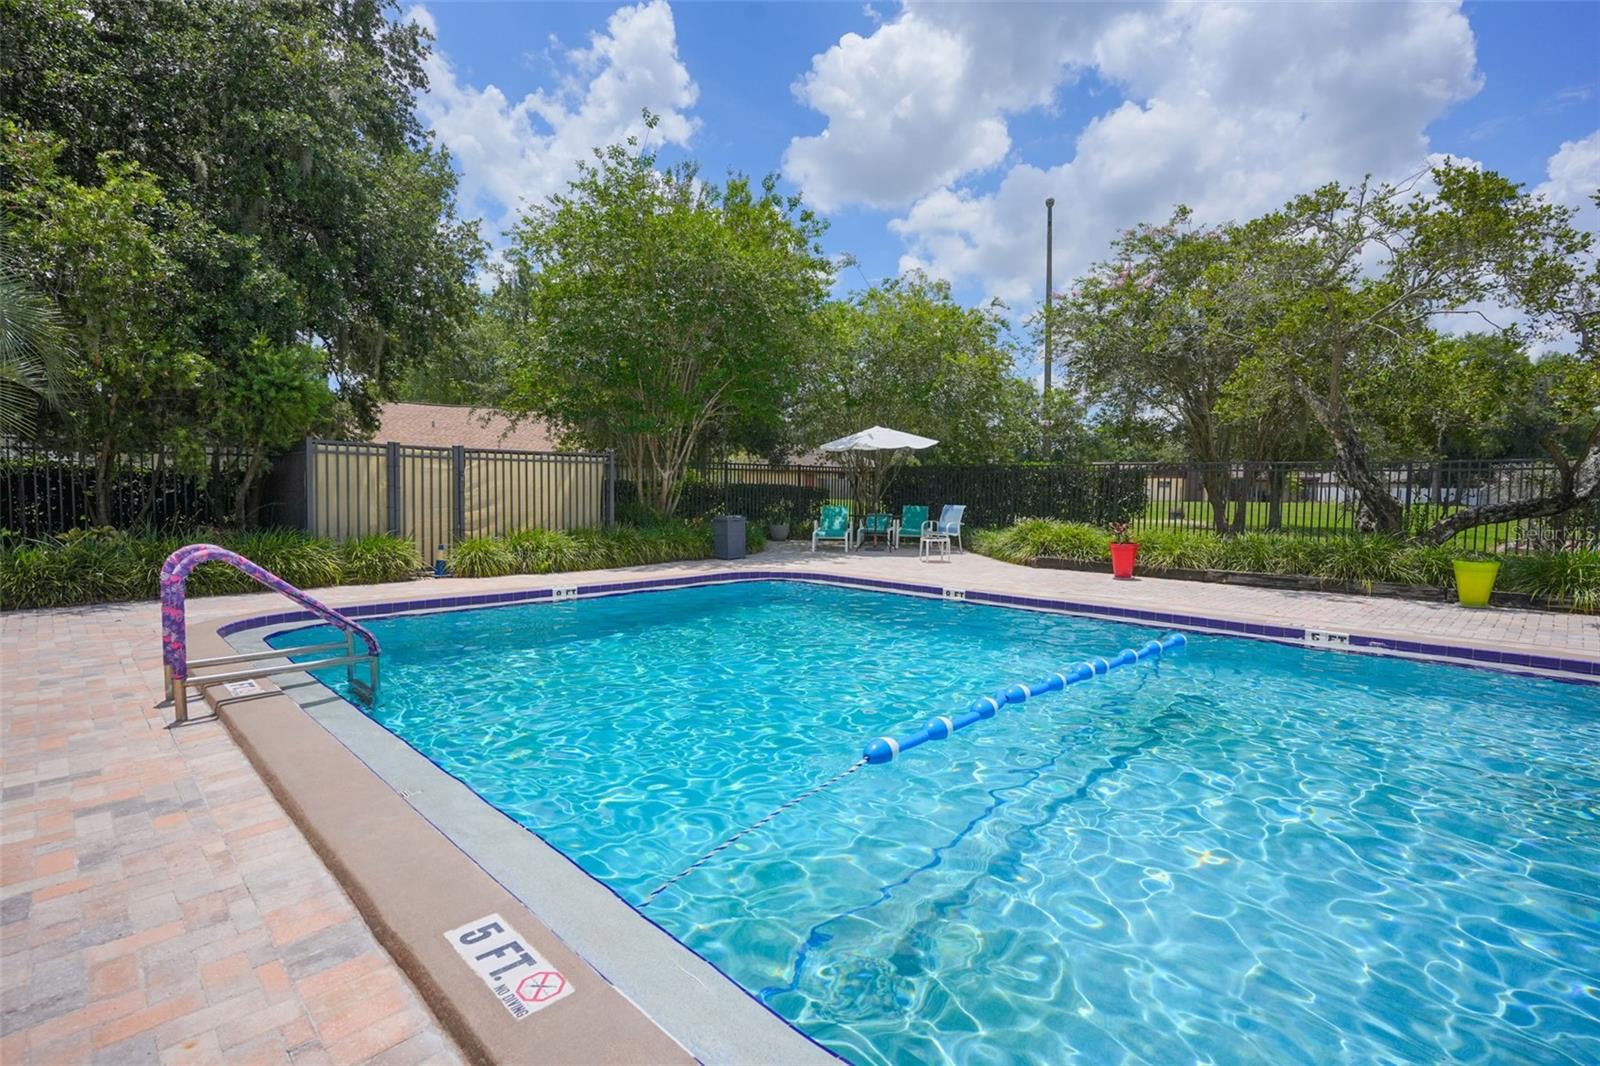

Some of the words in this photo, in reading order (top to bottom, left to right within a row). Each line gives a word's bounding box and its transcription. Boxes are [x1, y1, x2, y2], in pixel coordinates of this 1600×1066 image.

[459, 921, 504, 945] 5
[494, 983, 511, 997] NO
[502, 993, 529, 1018] DIVING
